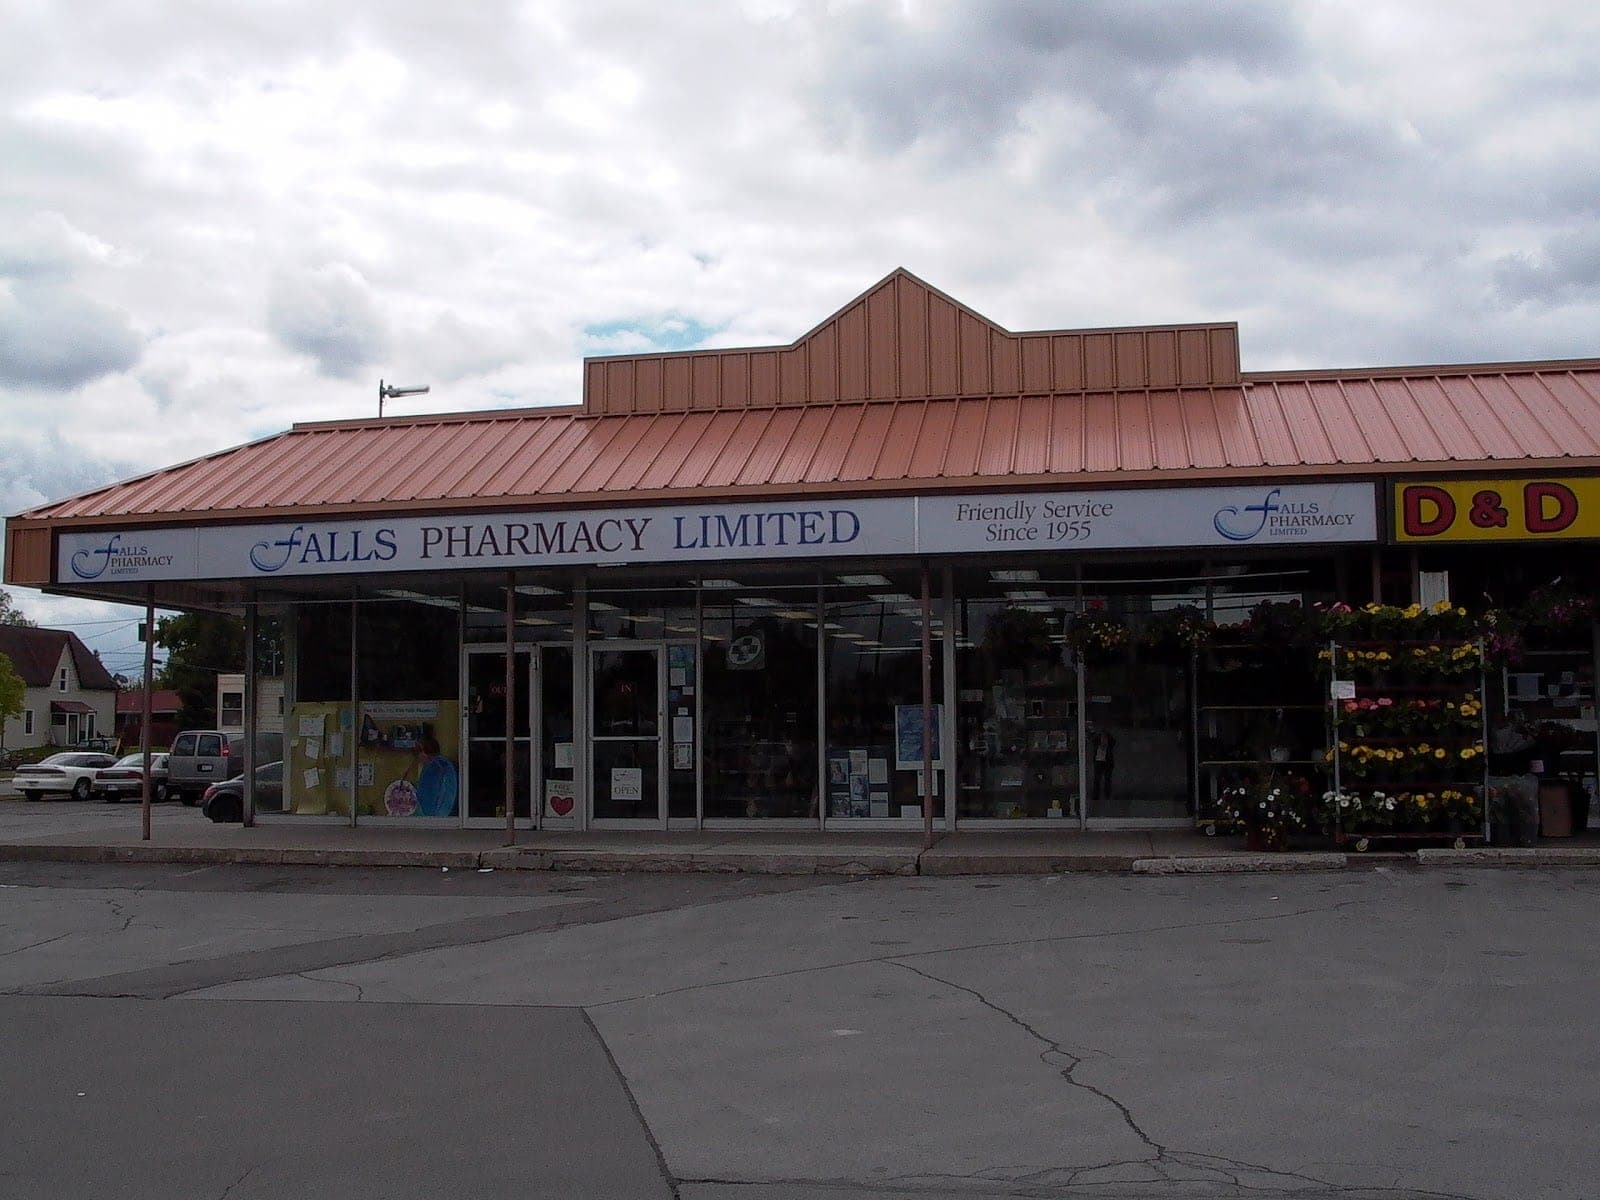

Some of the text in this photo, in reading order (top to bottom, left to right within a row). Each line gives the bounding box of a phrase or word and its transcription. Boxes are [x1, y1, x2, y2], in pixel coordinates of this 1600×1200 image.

[956, 500, 1113, 524] Friendly Service
[1402, 482, 1579, 537] D & D
[1269, 514, 1355, 528] PHARMACY
[420, 518, 652, 558] PHARMACY
[673, 510, 860, 549] LIMITED
[985, 520, 1092, 542] Since 1955
[1269, 528, 1308, 537] LIMITED
[111, 555, 174, 568] PHARMACY
[110, 567, 139, 575] LIMITED
[614, 786, 640, 795] OPEN
